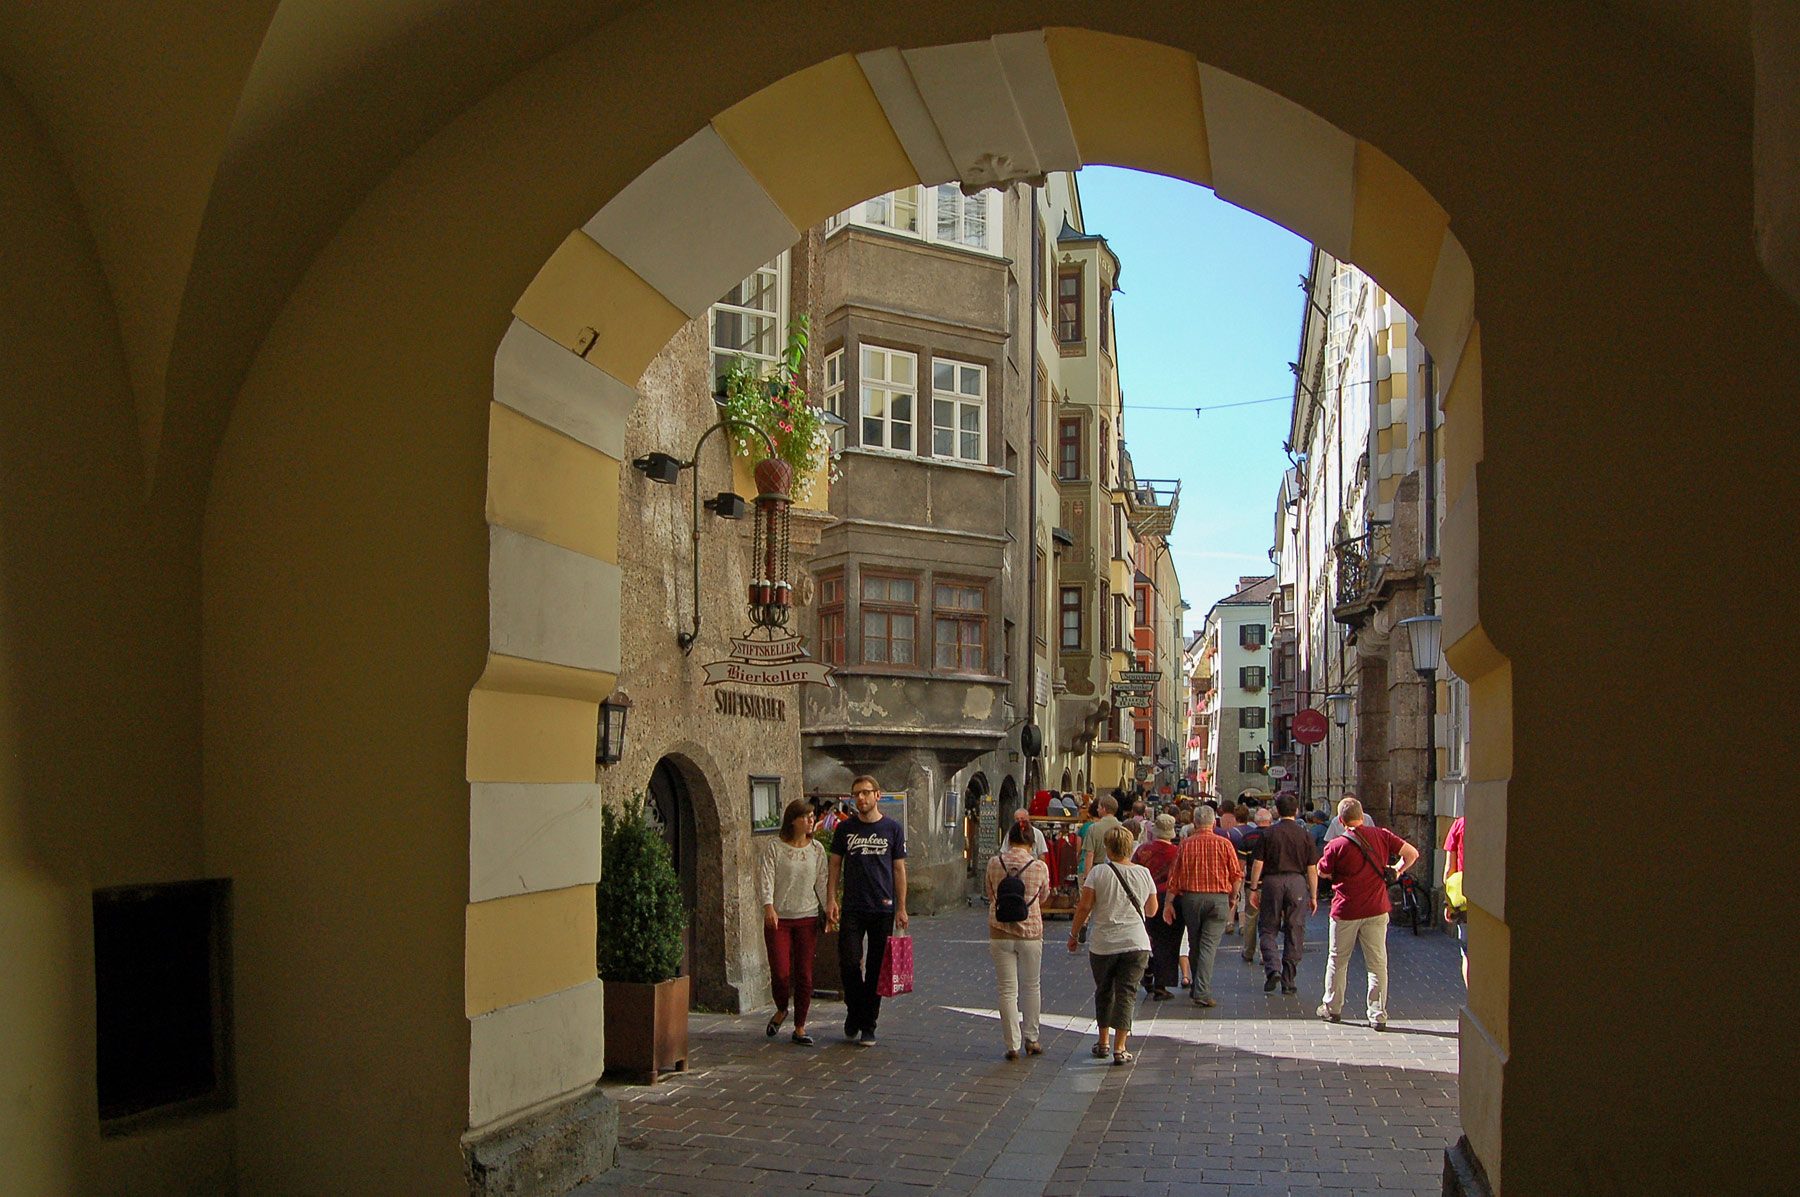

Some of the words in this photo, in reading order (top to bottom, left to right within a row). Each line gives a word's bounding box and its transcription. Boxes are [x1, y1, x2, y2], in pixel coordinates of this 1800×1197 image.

[737, 642, 796, 656] STIFTSKELLER
[728, 664, 808, 683] Bierkeller
[846, 833, 889, 851] Yankees
